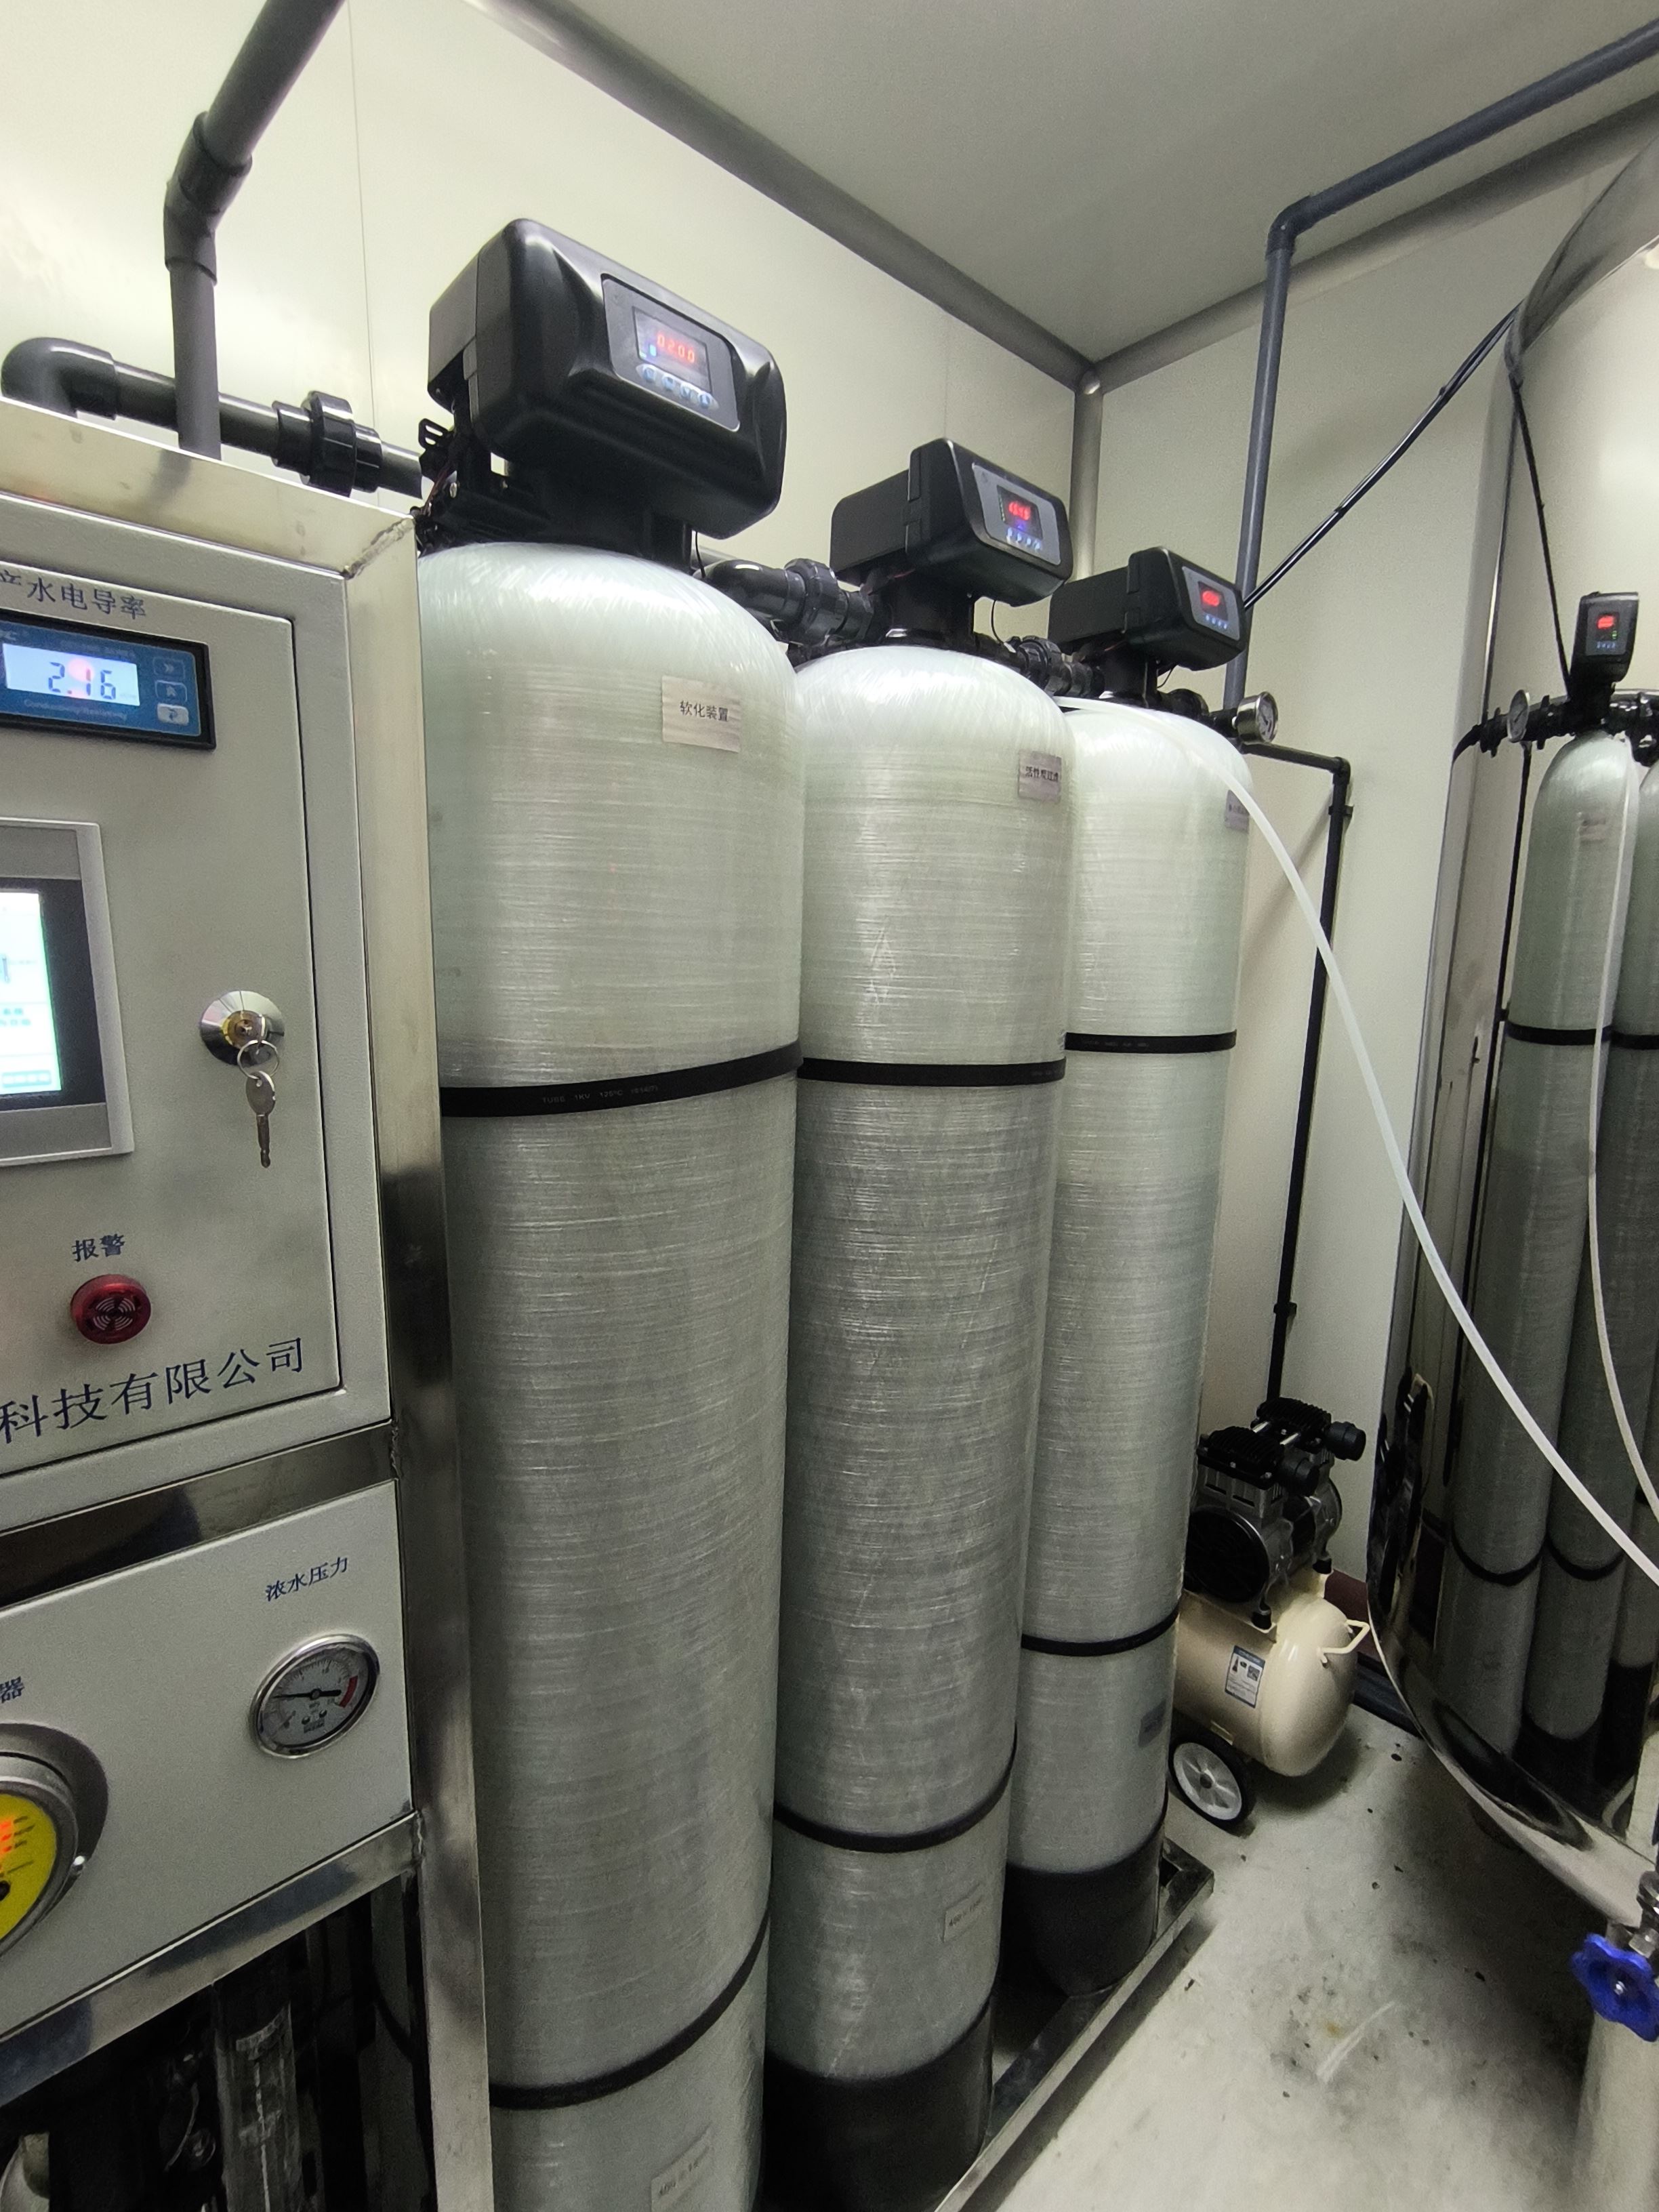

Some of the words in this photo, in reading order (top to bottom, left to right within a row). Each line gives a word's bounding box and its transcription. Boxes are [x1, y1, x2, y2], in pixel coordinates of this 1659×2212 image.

[48, 661, 116, 699] 2.16
[680, 700, 729, 722] 软化装置
[72, 1233, 125, 1262] 报警
[0, 1337, 303, 1444] 科技有限公司
[264, 1557, 348, 1602] 浓水压力
